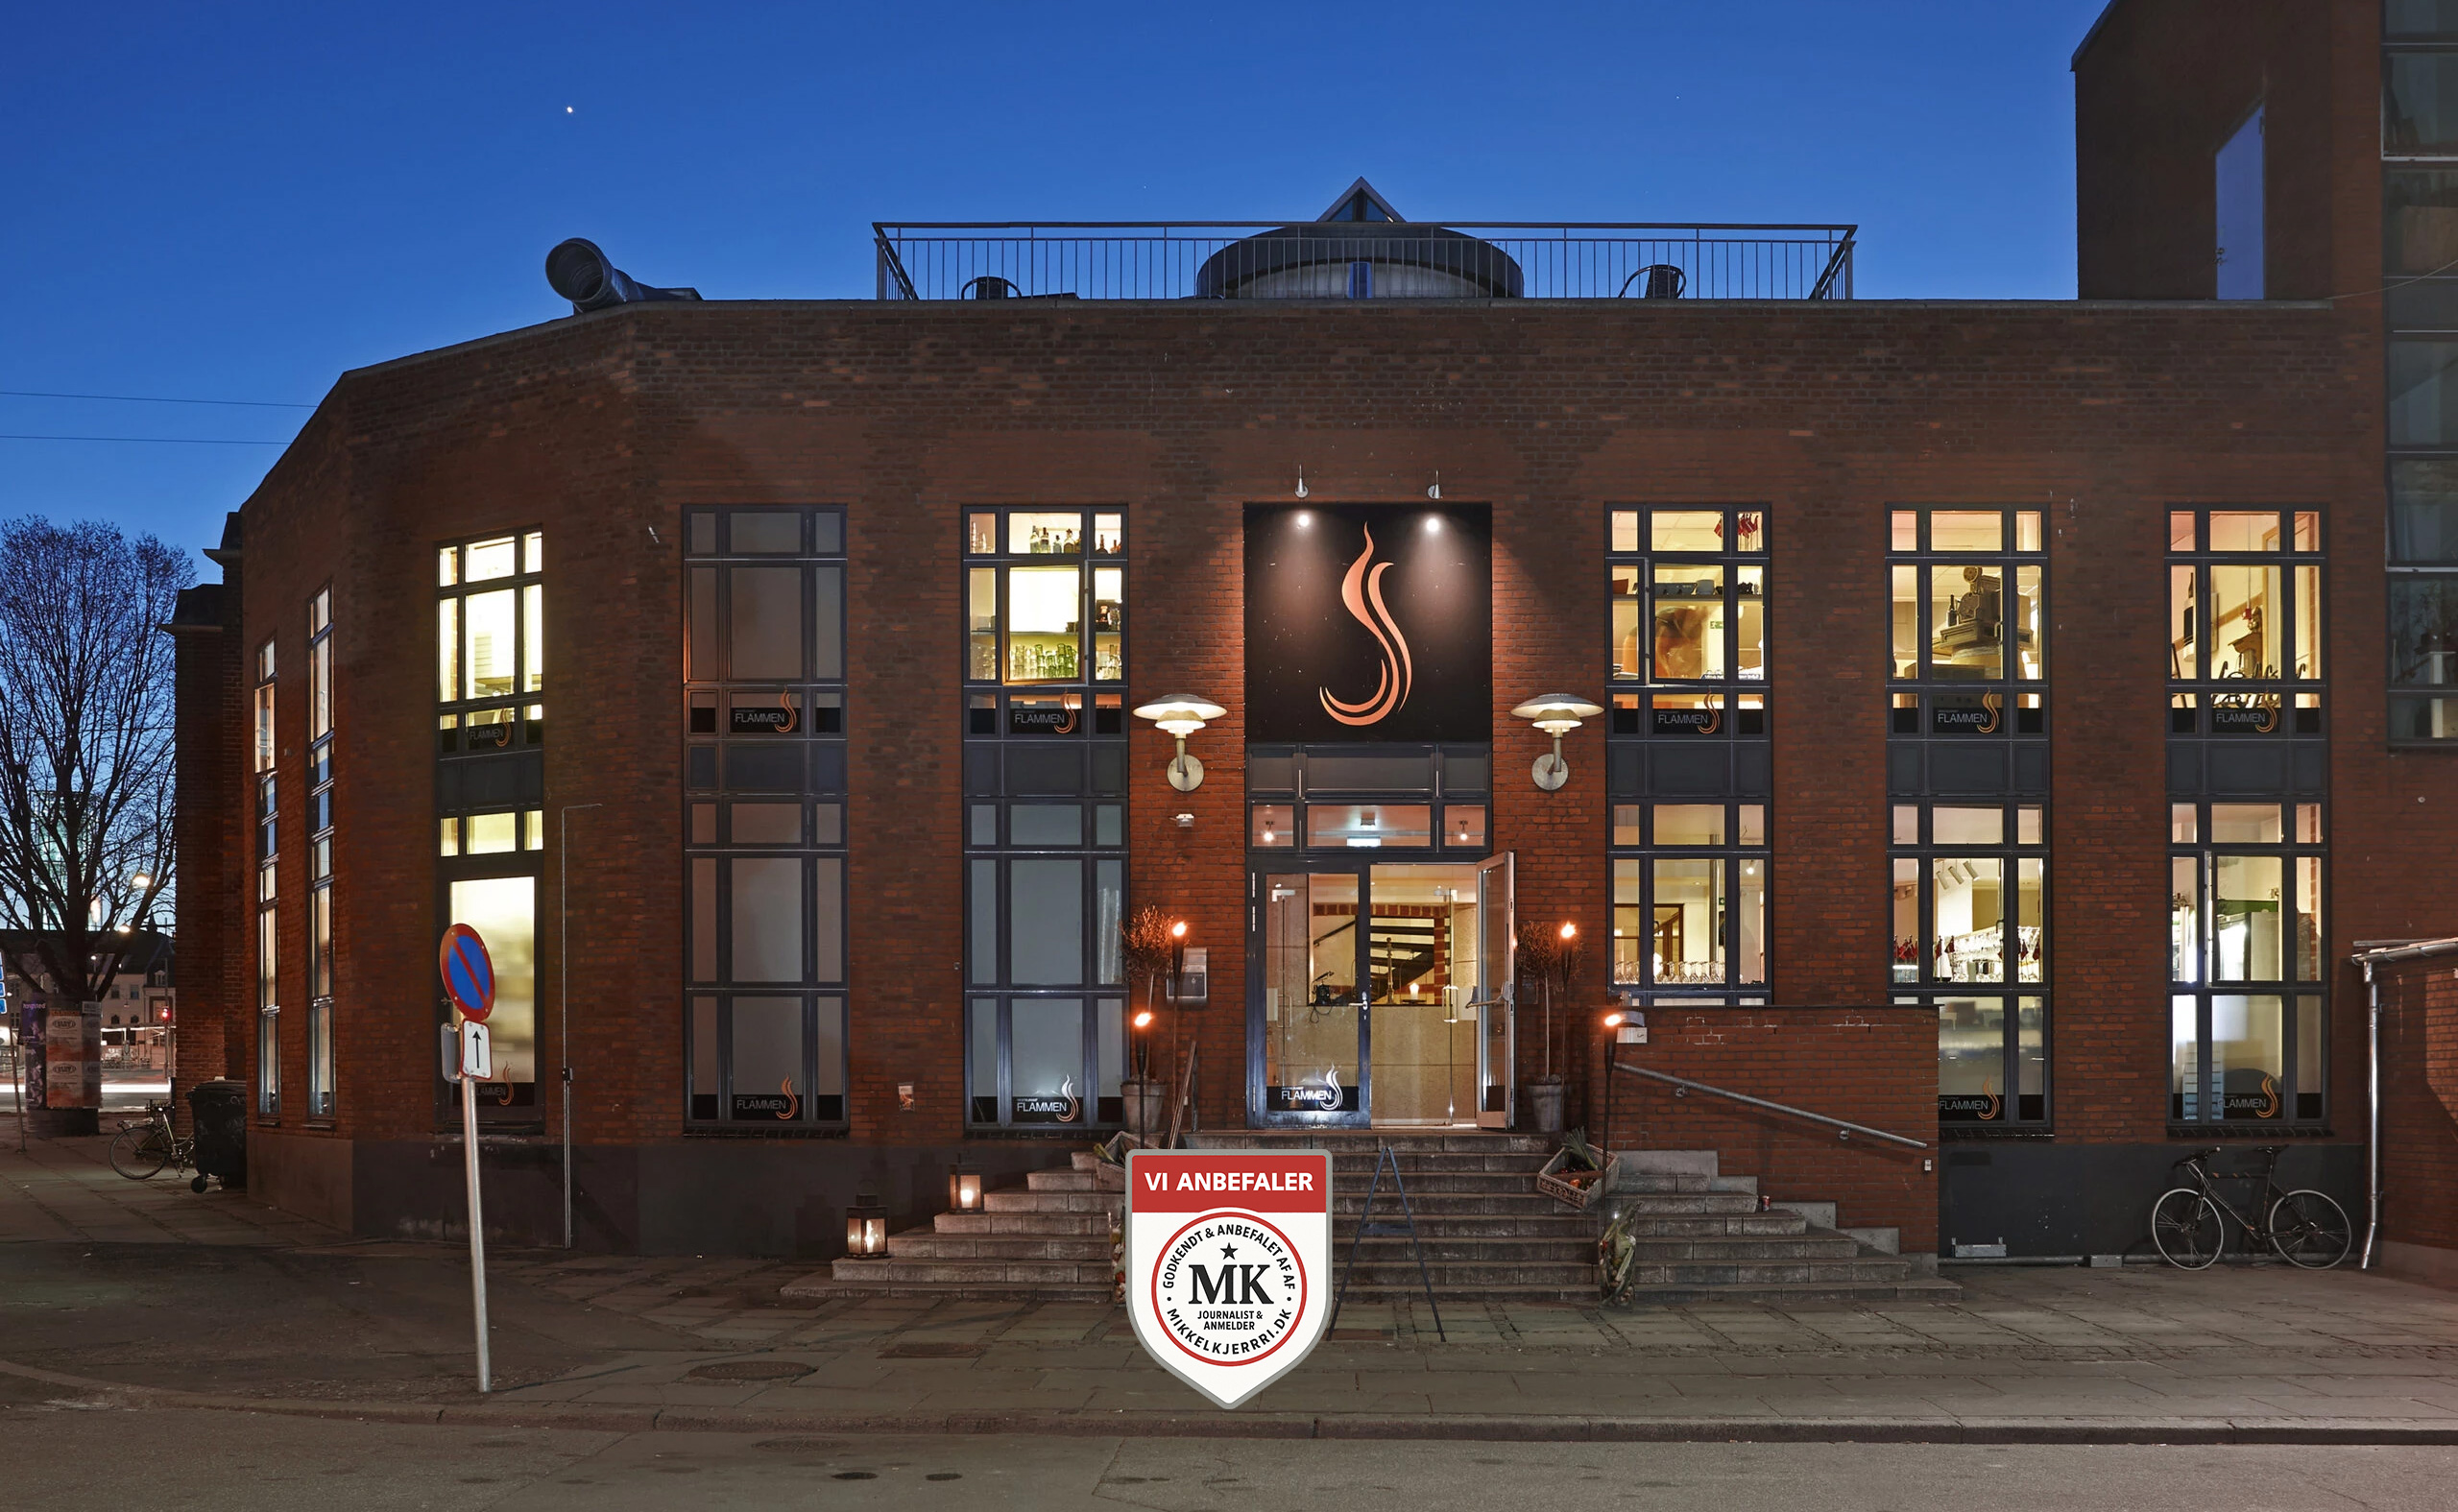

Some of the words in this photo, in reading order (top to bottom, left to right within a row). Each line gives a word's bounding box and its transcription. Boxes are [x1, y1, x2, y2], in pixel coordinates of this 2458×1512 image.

[735, 713, 784, 723] FLAMMEN
[1014, 714, 1065, 724] FLAMMEN
[1658, 714, 1708, 724] FLAMMEN
[1938, 713, 1988, 723] FLAMMEN
[2216, 713, 2265, 723] FLAMMEN
[470, 729, 503, 740] FLAMMEN
[475, 1087, 506, 1096] LAMMEN
[1281, 1090, 1332, 1100] FLAMMEN
[736, 1099, 786, 1110] FLAMMEN
[1017, 1102, 1067, 1112] FLAMMEN
[1939, 1100, 1988, 1110] FLAMMEN
